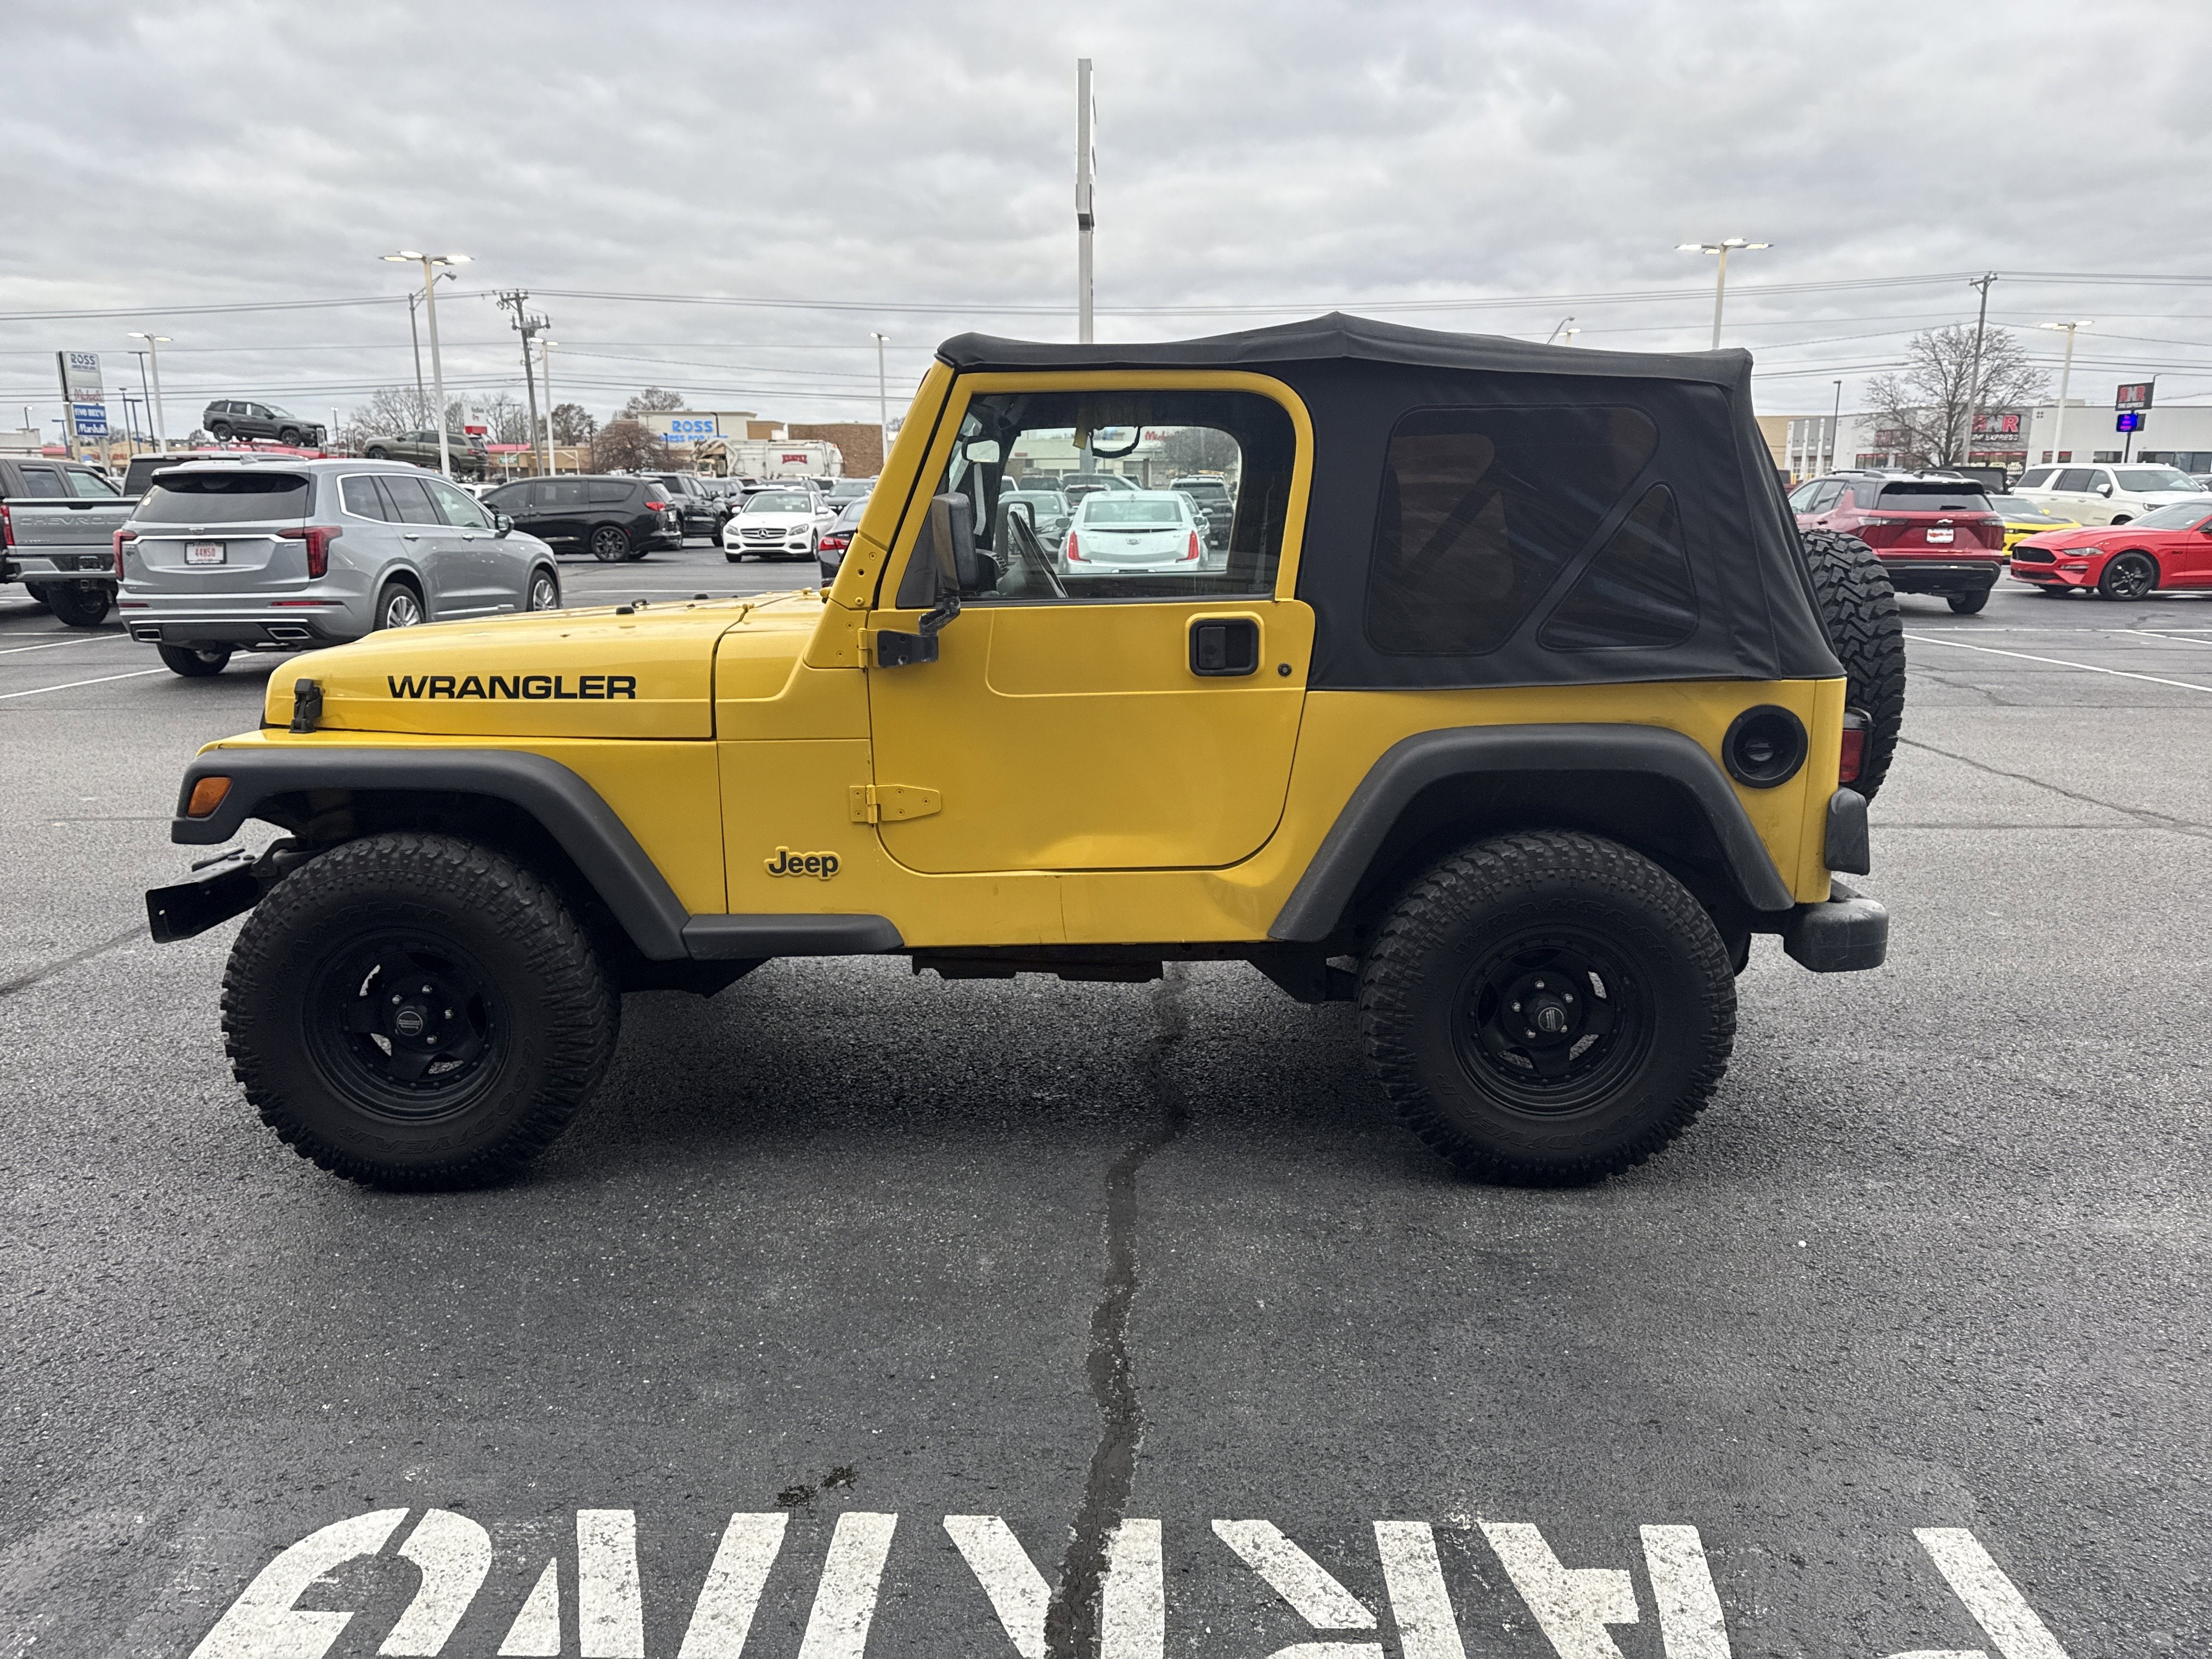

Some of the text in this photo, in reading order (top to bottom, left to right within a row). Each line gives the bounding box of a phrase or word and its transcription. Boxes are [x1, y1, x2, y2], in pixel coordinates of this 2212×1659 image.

[70, 354, 95, 365] ROSS
[672, 420, 713, 432] ROSS
[387, 675, 636, 699] WRANGLER
[769, 851, 838, 877] Jeep
